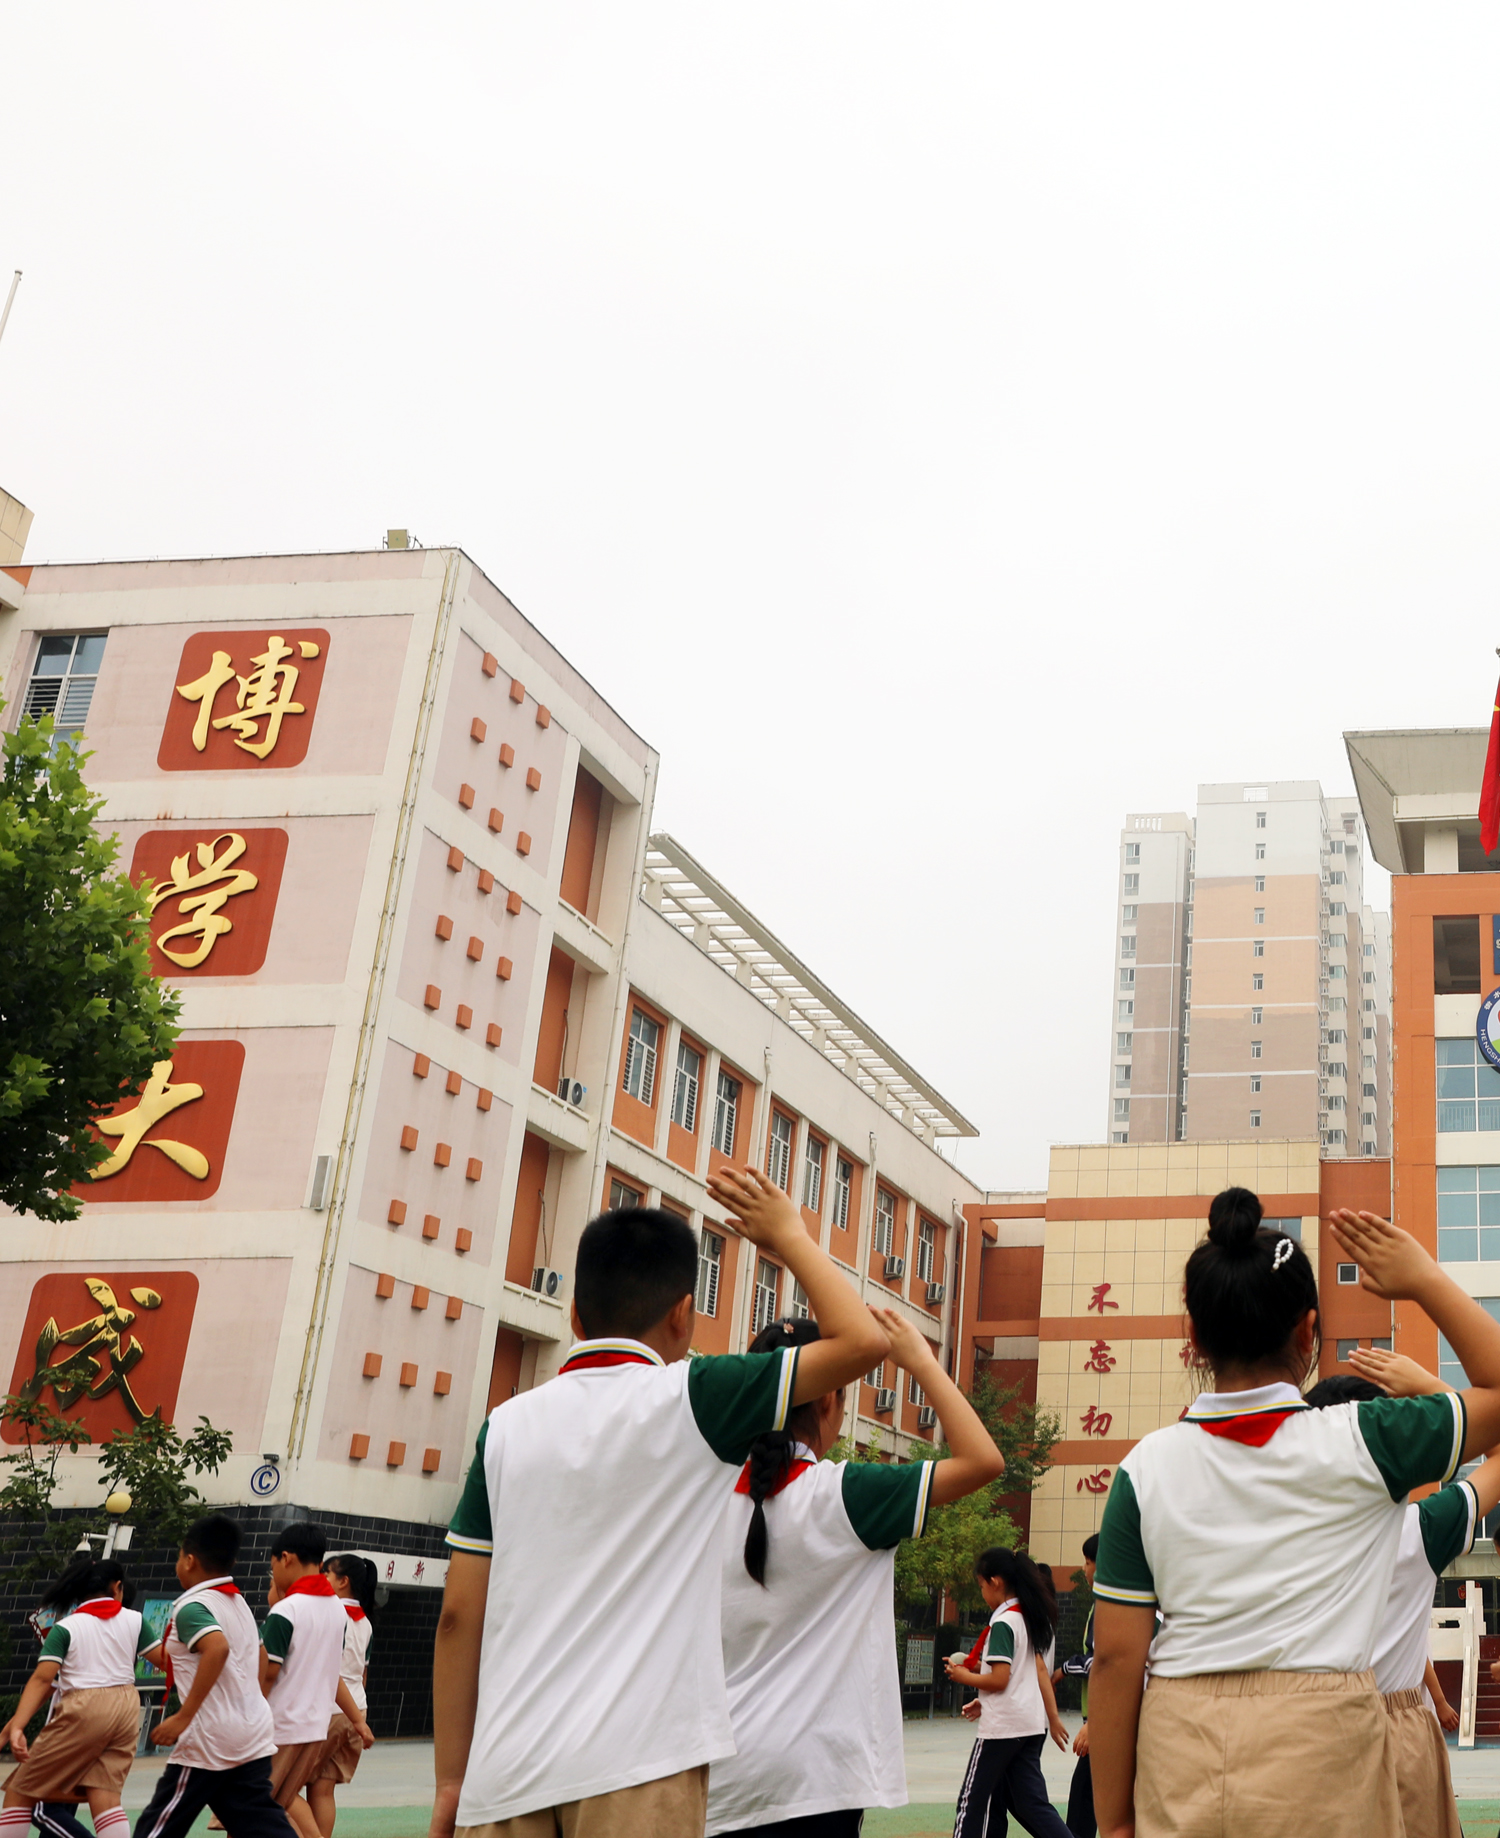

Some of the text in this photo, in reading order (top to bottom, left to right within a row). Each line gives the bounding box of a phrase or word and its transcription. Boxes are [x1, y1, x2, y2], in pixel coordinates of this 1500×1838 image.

[1076, 1282, 1120, 1494] 不忘初心
[258, 1470, 273, 1490] C
[385, 1560, 449, 1584] 日新
